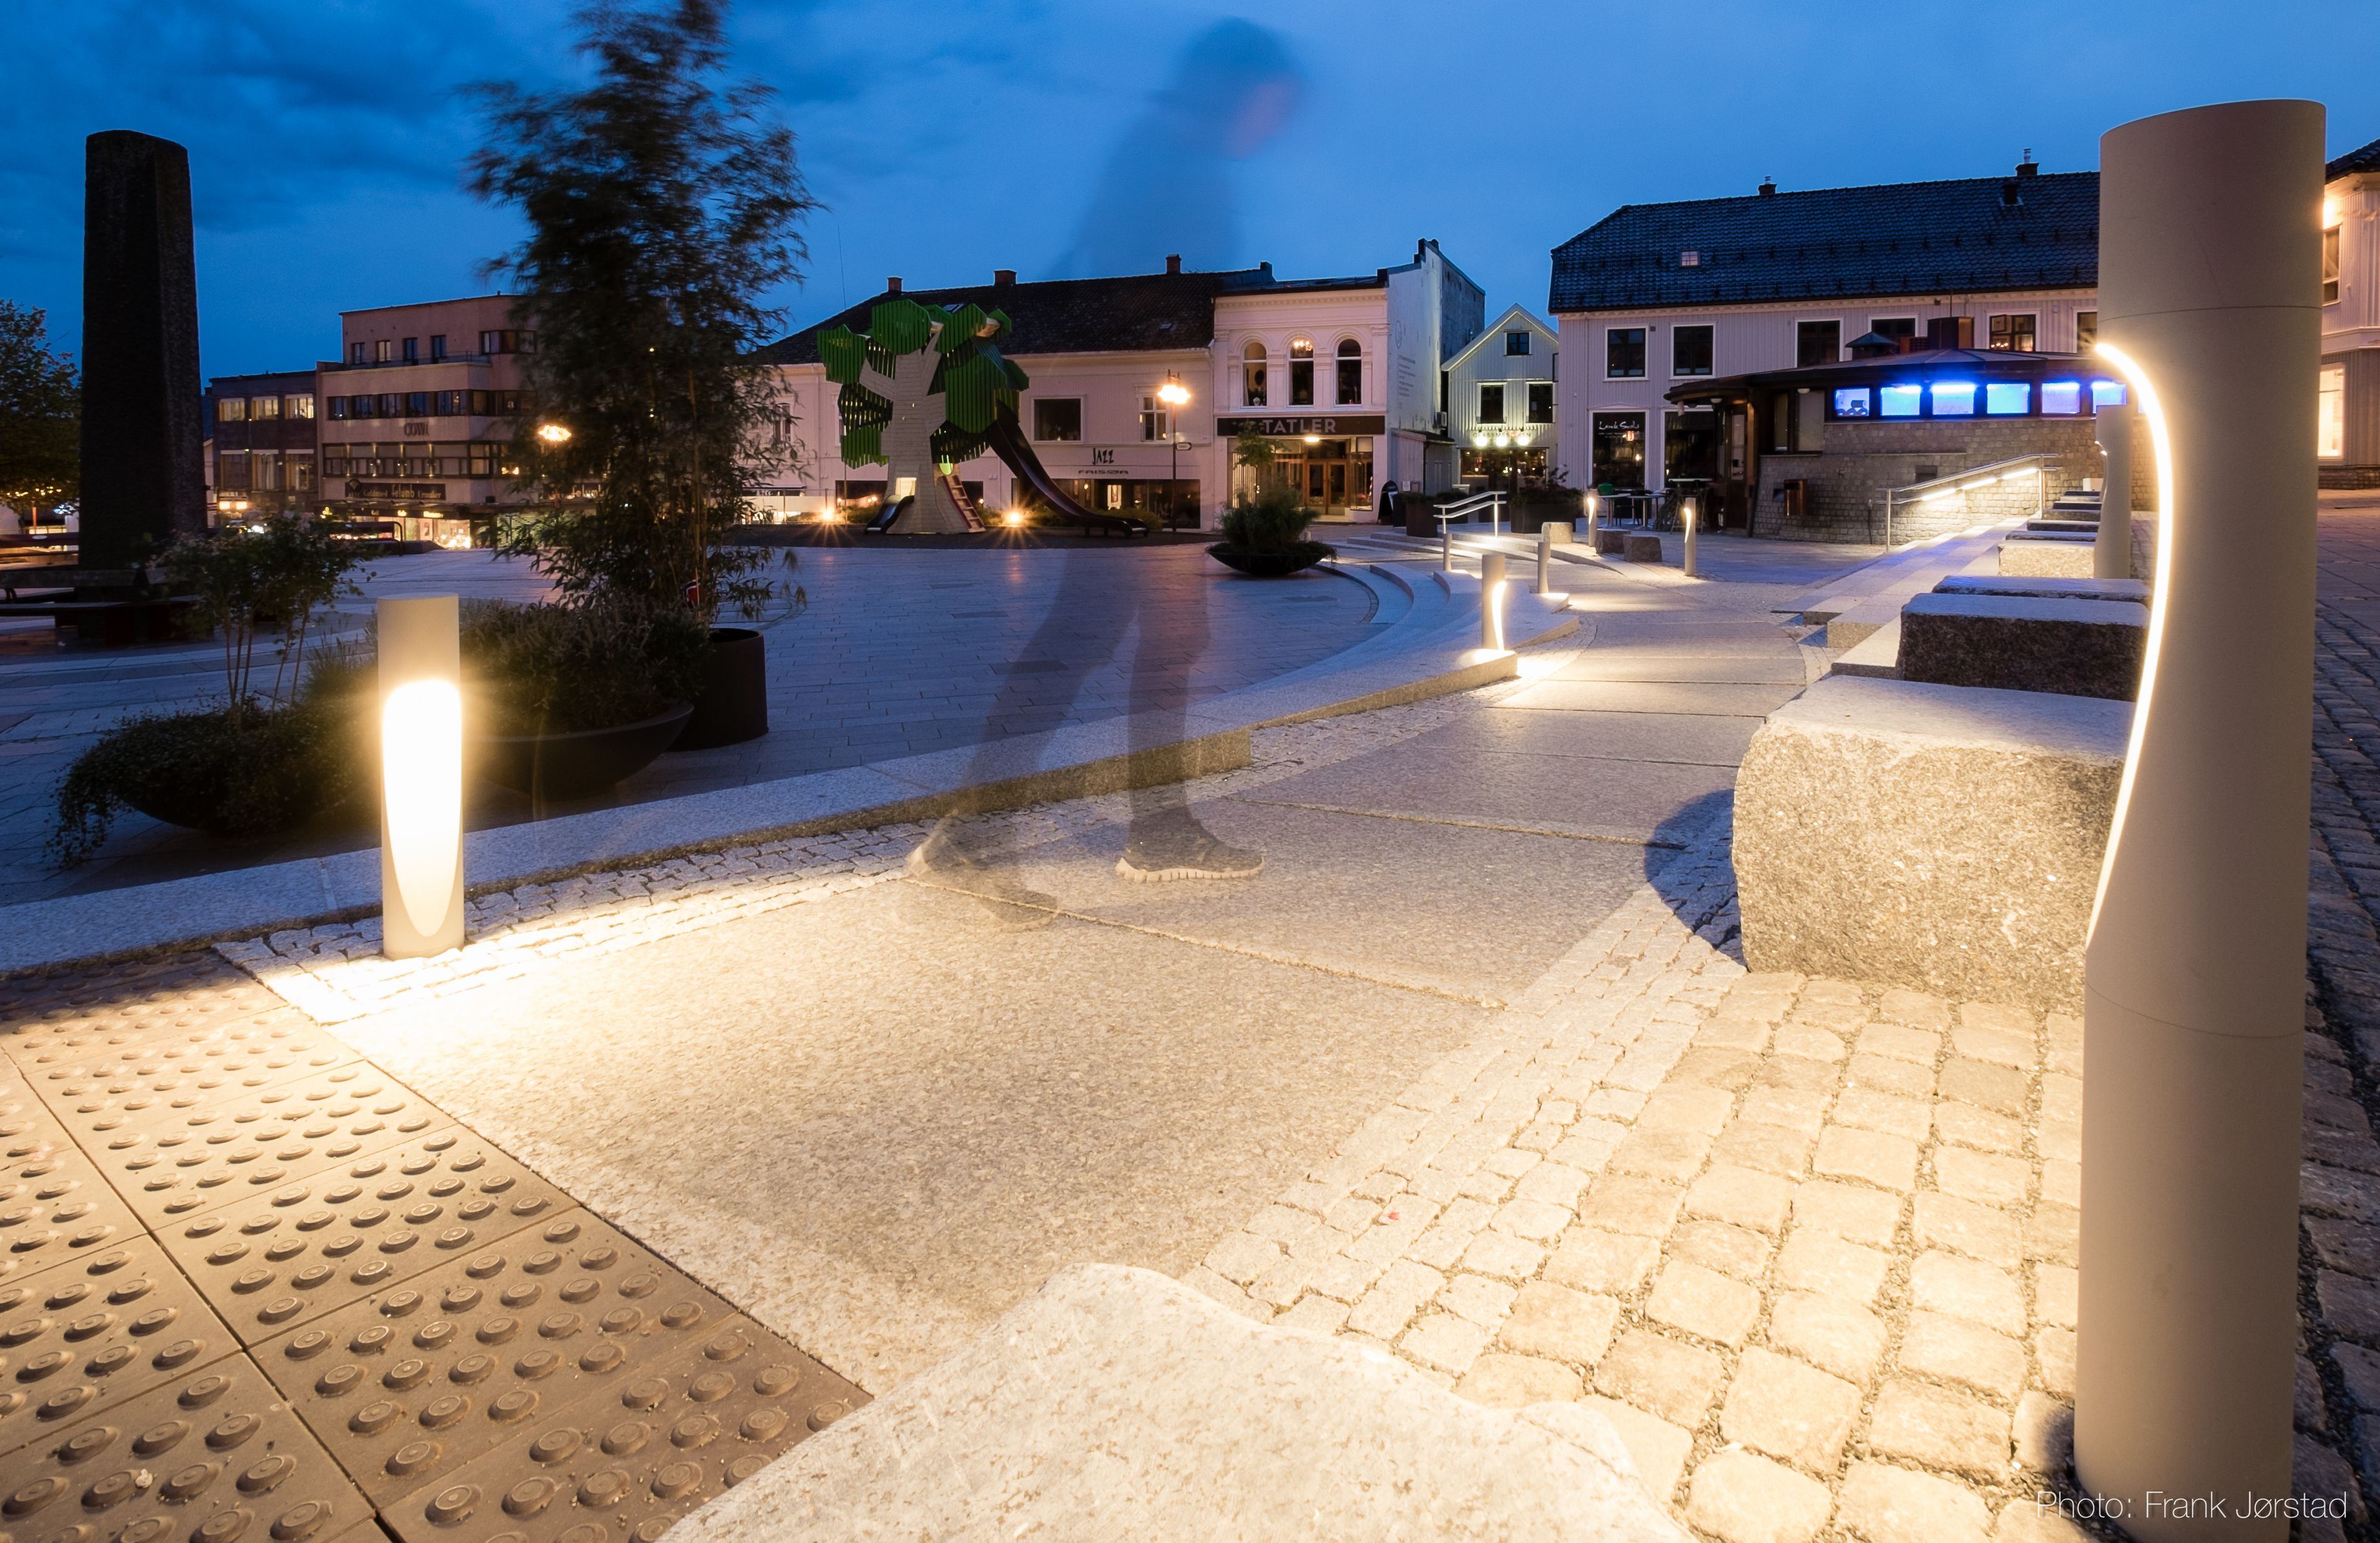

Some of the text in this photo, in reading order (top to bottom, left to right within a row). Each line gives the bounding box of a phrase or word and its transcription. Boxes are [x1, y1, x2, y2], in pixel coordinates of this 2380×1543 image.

[403, 422, 429, 436] COWI
[1263, 418, 1336, 433] TATLER
[1092, 448, 1114, 465] JAZZ
